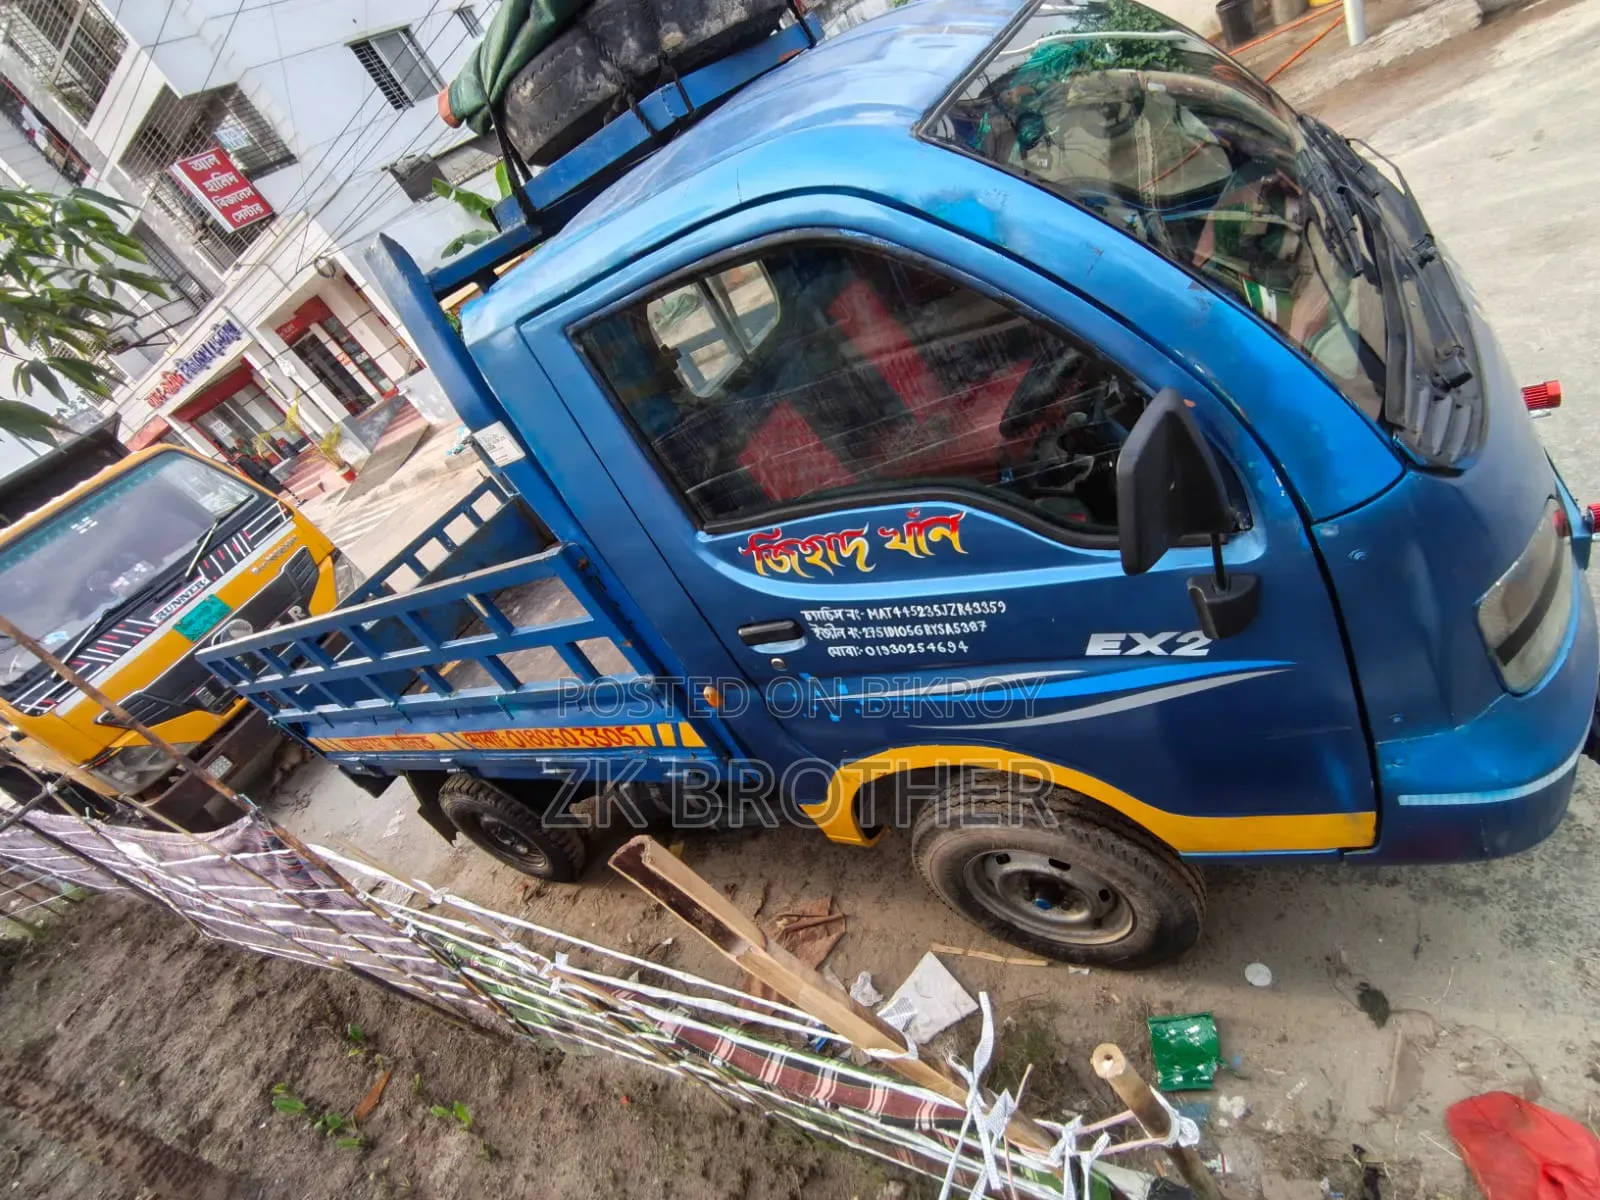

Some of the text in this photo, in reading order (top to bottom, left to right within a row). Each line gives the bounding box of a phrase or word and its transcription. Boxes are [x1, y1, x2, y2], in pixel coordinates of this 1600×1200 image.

[188, 154, 221, 171] আল
[738, 506, 968, 579] জিহাদ খাঁন
[155, 579, 207, 621] RUNNER
[1085, 630, 1212, 657] EX2
